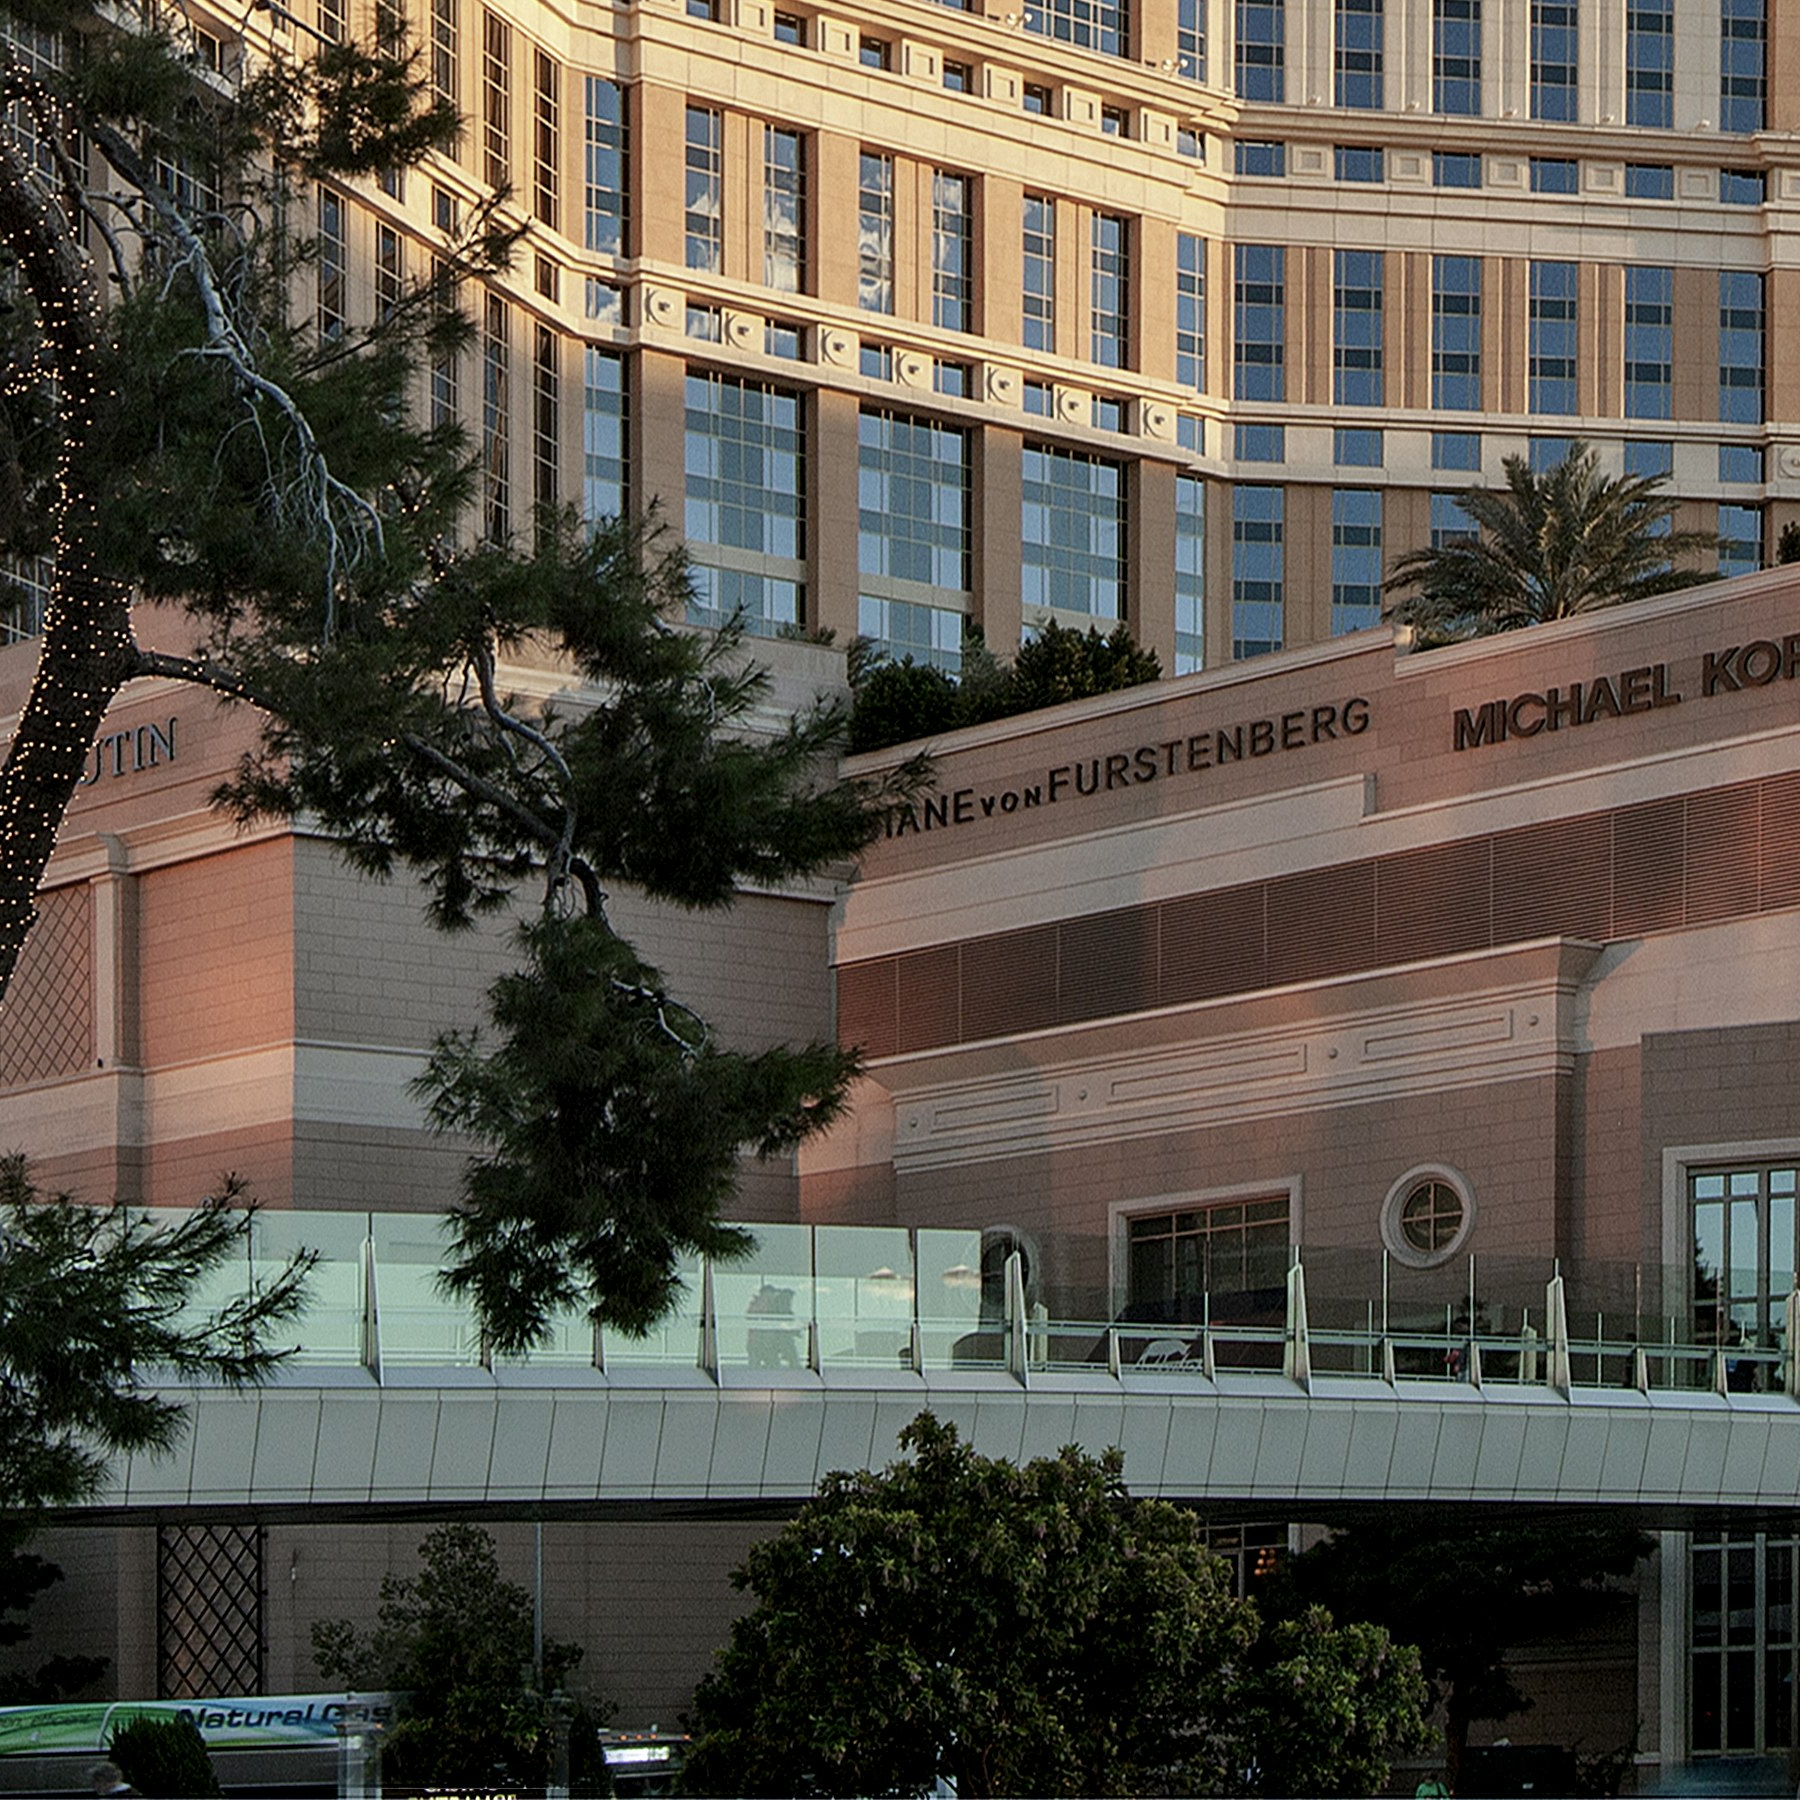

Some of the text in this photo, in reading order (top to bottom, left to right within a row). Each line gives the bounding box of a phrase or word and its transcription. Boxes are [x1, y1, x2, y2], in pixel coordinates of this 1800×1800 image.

[1453, 663, 1682, 752] MICHAEL
[884, 788, 975, 839] IANE
[1049, 697, 1371, 802] FURSTENBERG
[176, 1703, 316, 1730] Natural
